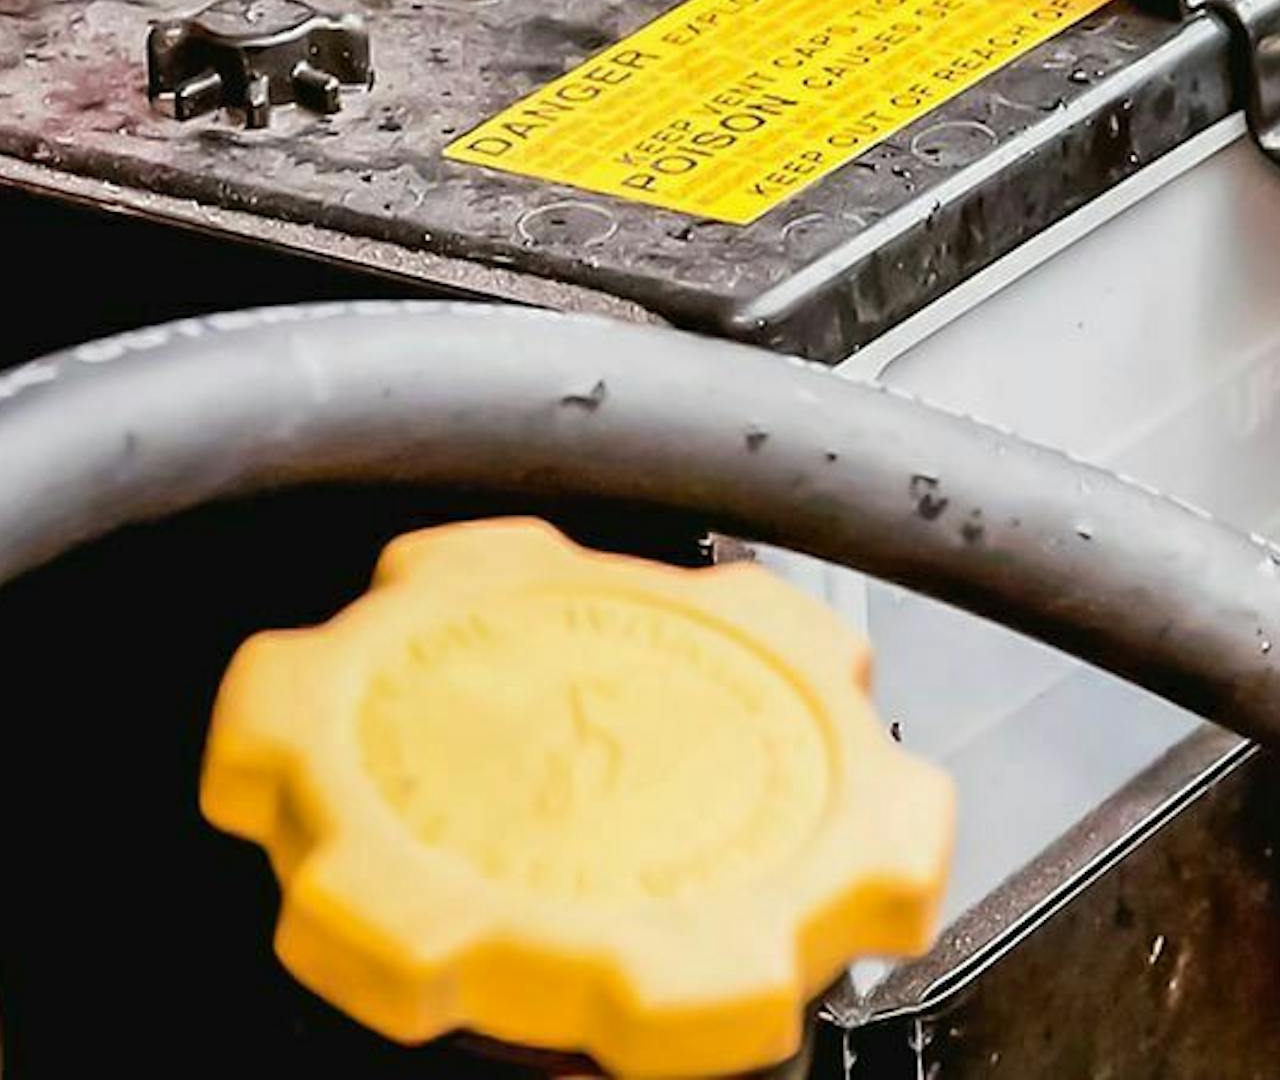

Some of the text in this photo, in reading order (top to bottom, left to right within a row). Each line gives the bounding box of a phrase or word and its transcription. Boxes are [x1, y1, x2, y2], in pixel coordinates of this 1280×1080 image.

[469, 48, 660, 157] DANGER
[615, 119, 692, 166] KEEP
[704, 72, 779, 116] VENT
[772, 23, 857, 71] CAPS
[620, 92, 799, 194] POISON
[802, 21, 923, 89] CAUSES
[749, 150, 824, 199] KEEP
[826, 109, 890, 149] OUT
[890, 82, 934, 110] OF
[932, 23, 1031, 84] REACH
